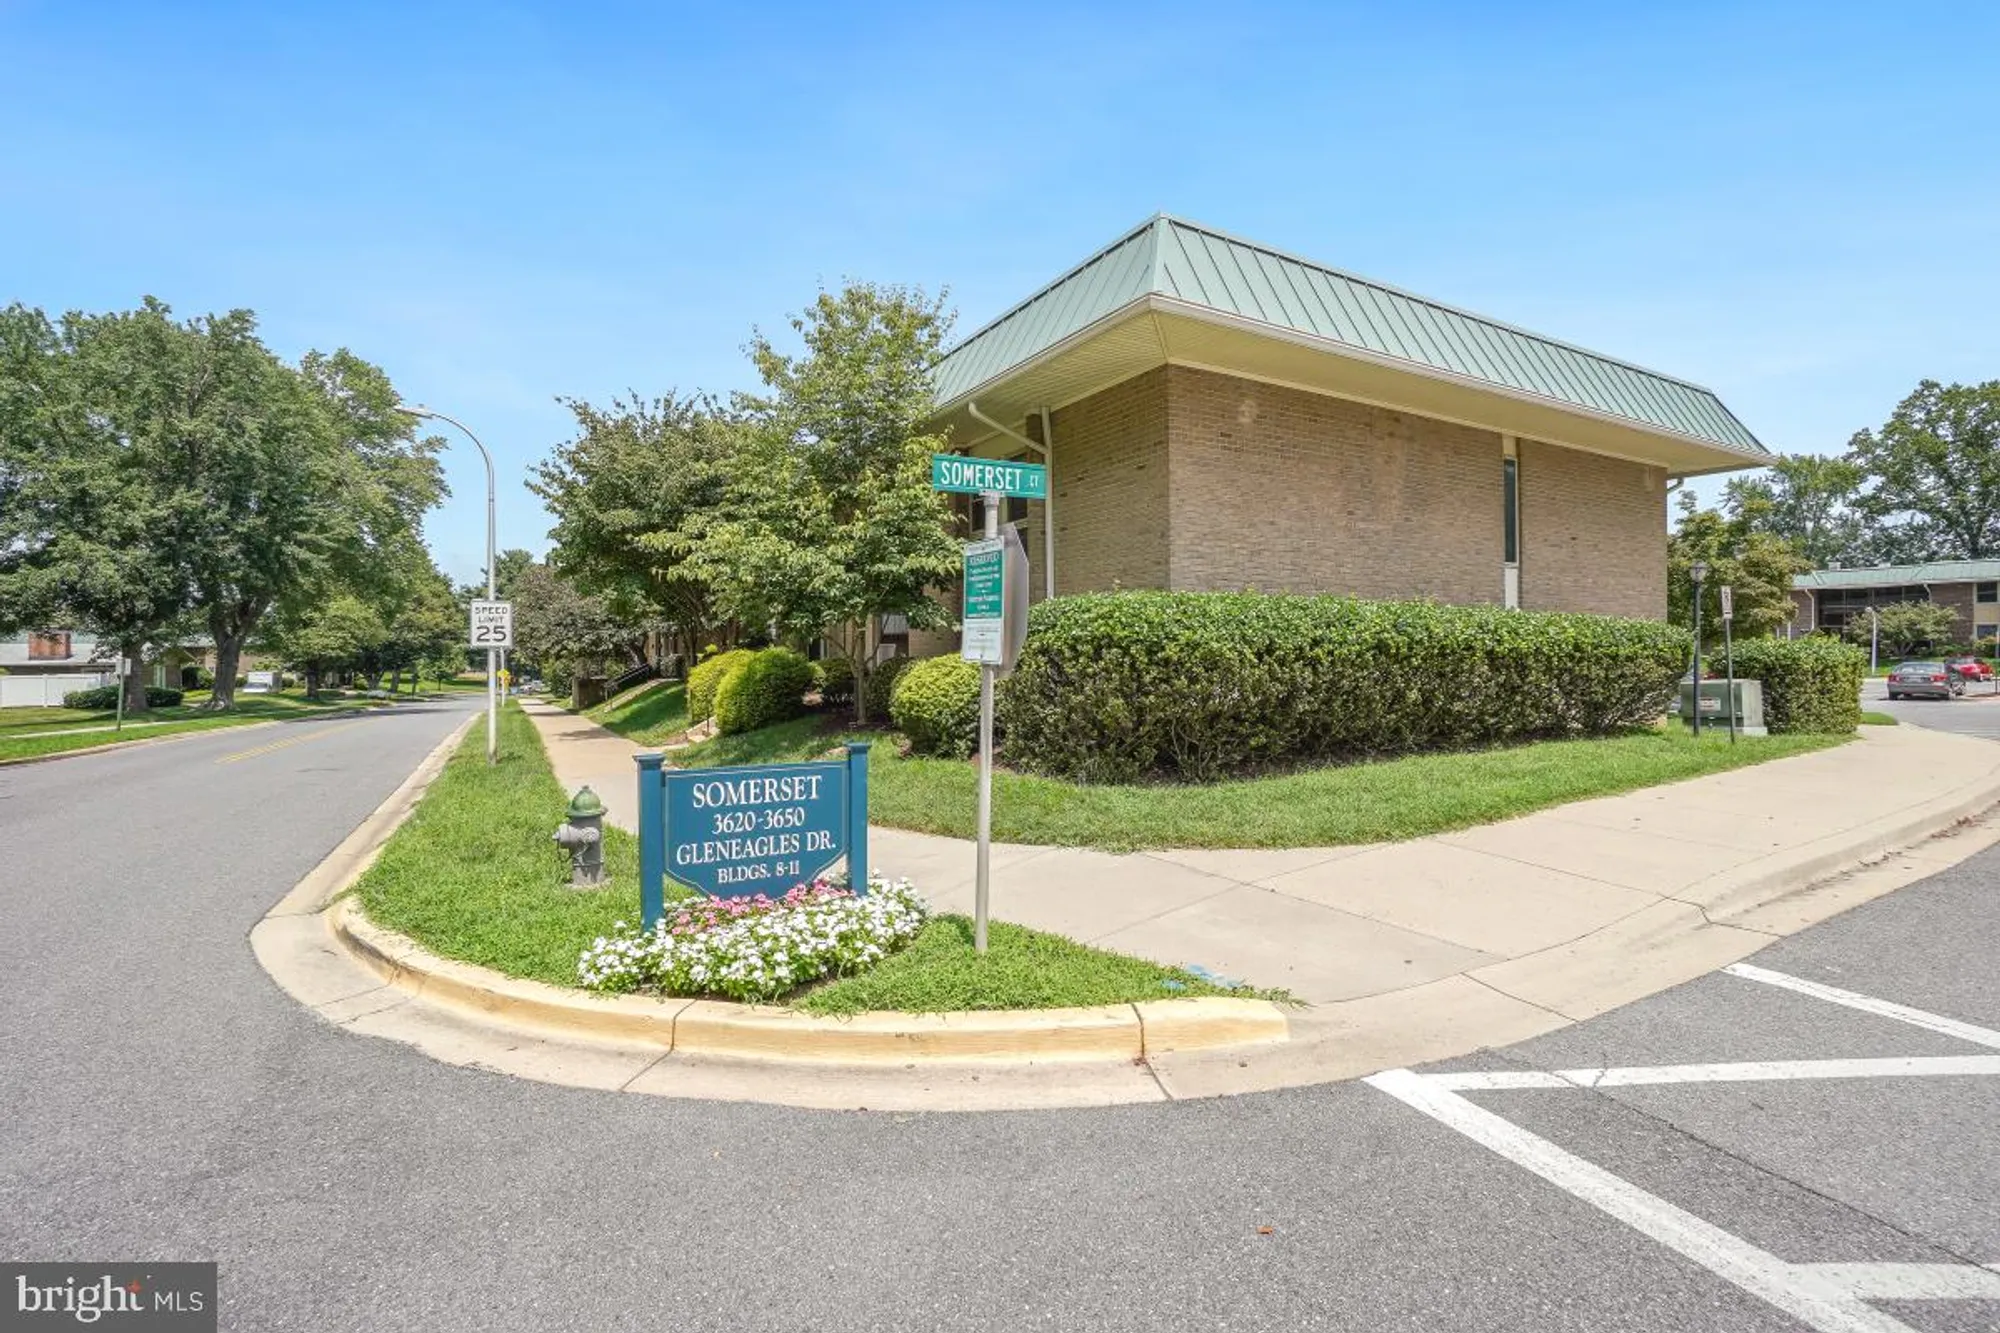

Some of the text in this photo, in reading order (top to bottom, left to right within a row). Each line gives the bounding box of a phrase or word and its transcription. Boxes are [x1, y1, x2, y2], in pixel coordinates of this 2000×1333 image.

[941, 461, 1022, 490] SOMERSET
[475, 606, 508, 615] SPEED
[476, 625, 507, 642] 25
[693, 775, 822, 808] SOMERSET
[712, 807, 805, 834] 3620-3650
[676, 830, 836, 865] GLENEAGLES DR.
[717, 860, 800, 884] BLDGS. 8-11
